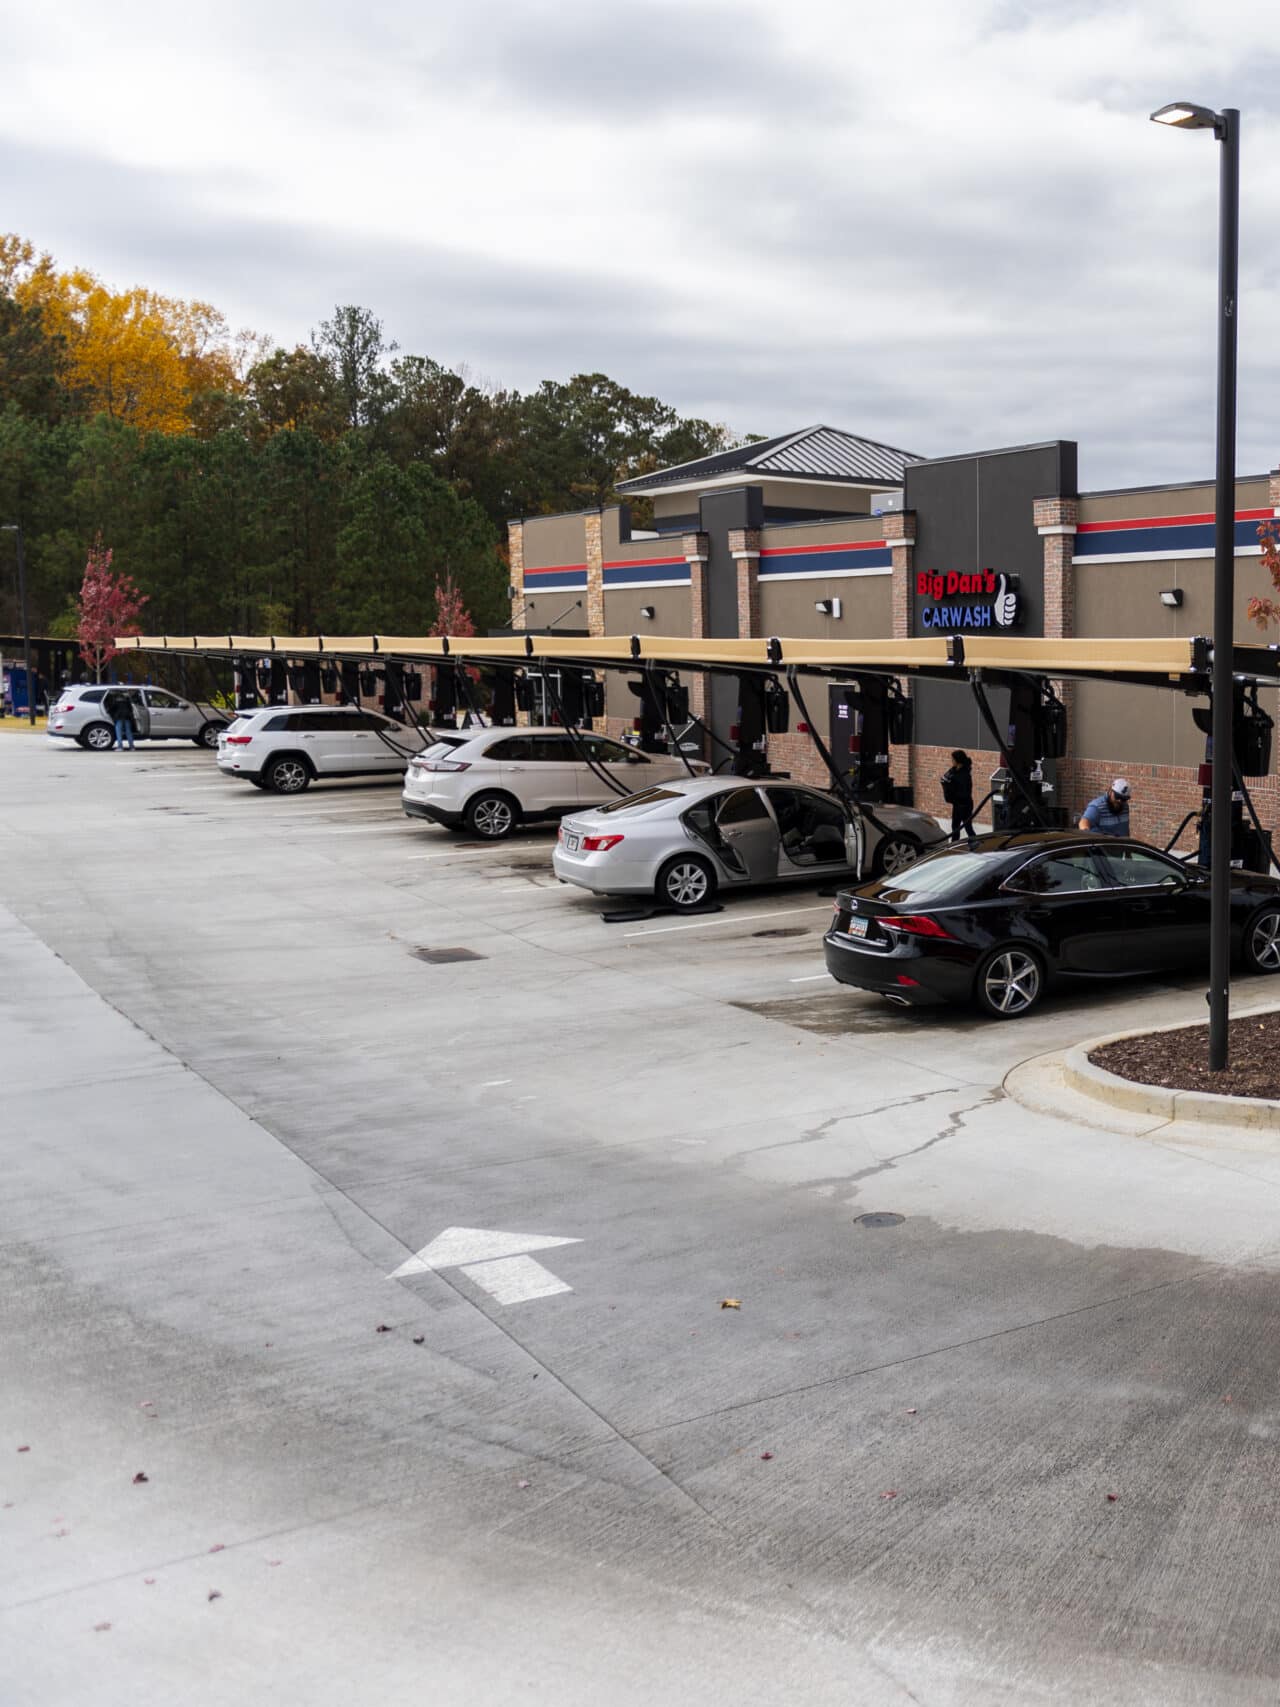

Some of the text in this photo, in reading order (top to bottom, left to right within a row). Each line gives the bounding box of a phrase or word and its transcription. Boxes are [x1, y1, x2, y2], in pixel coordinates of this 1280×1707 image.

[917, 568, 995, 600] Big Dan's
[922, 605, 991, 627] CARWASH
